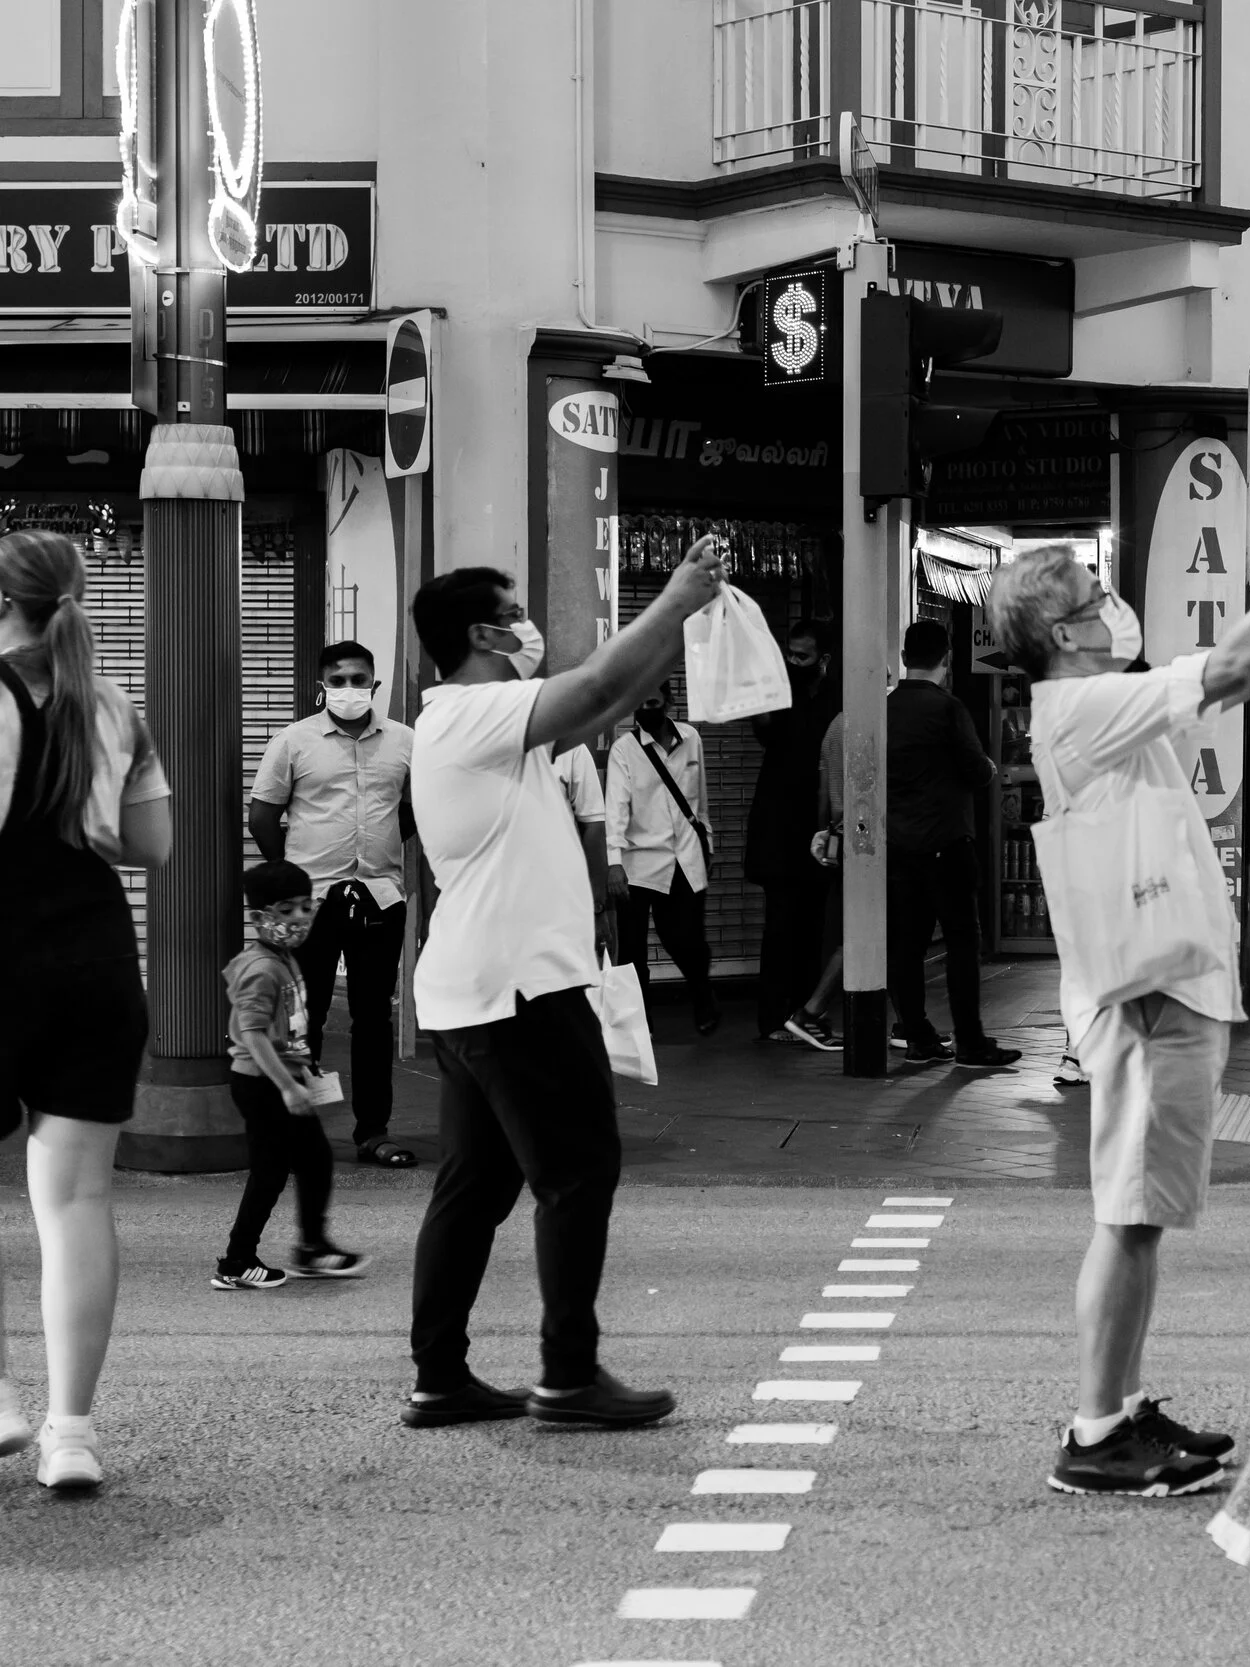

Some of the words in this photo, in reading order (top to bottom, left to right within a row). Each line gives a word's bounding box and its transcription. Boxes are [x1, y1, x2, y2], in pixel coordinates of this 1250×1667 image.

[252, 223, 349, 272] TD
[294, 293, 365, 305] 2012/00171
[947, 458, 1017, 480] PHOTO
[1024, 455, 1103, 477] STUDIO
[1187, 451, 1228, 795] SATA
